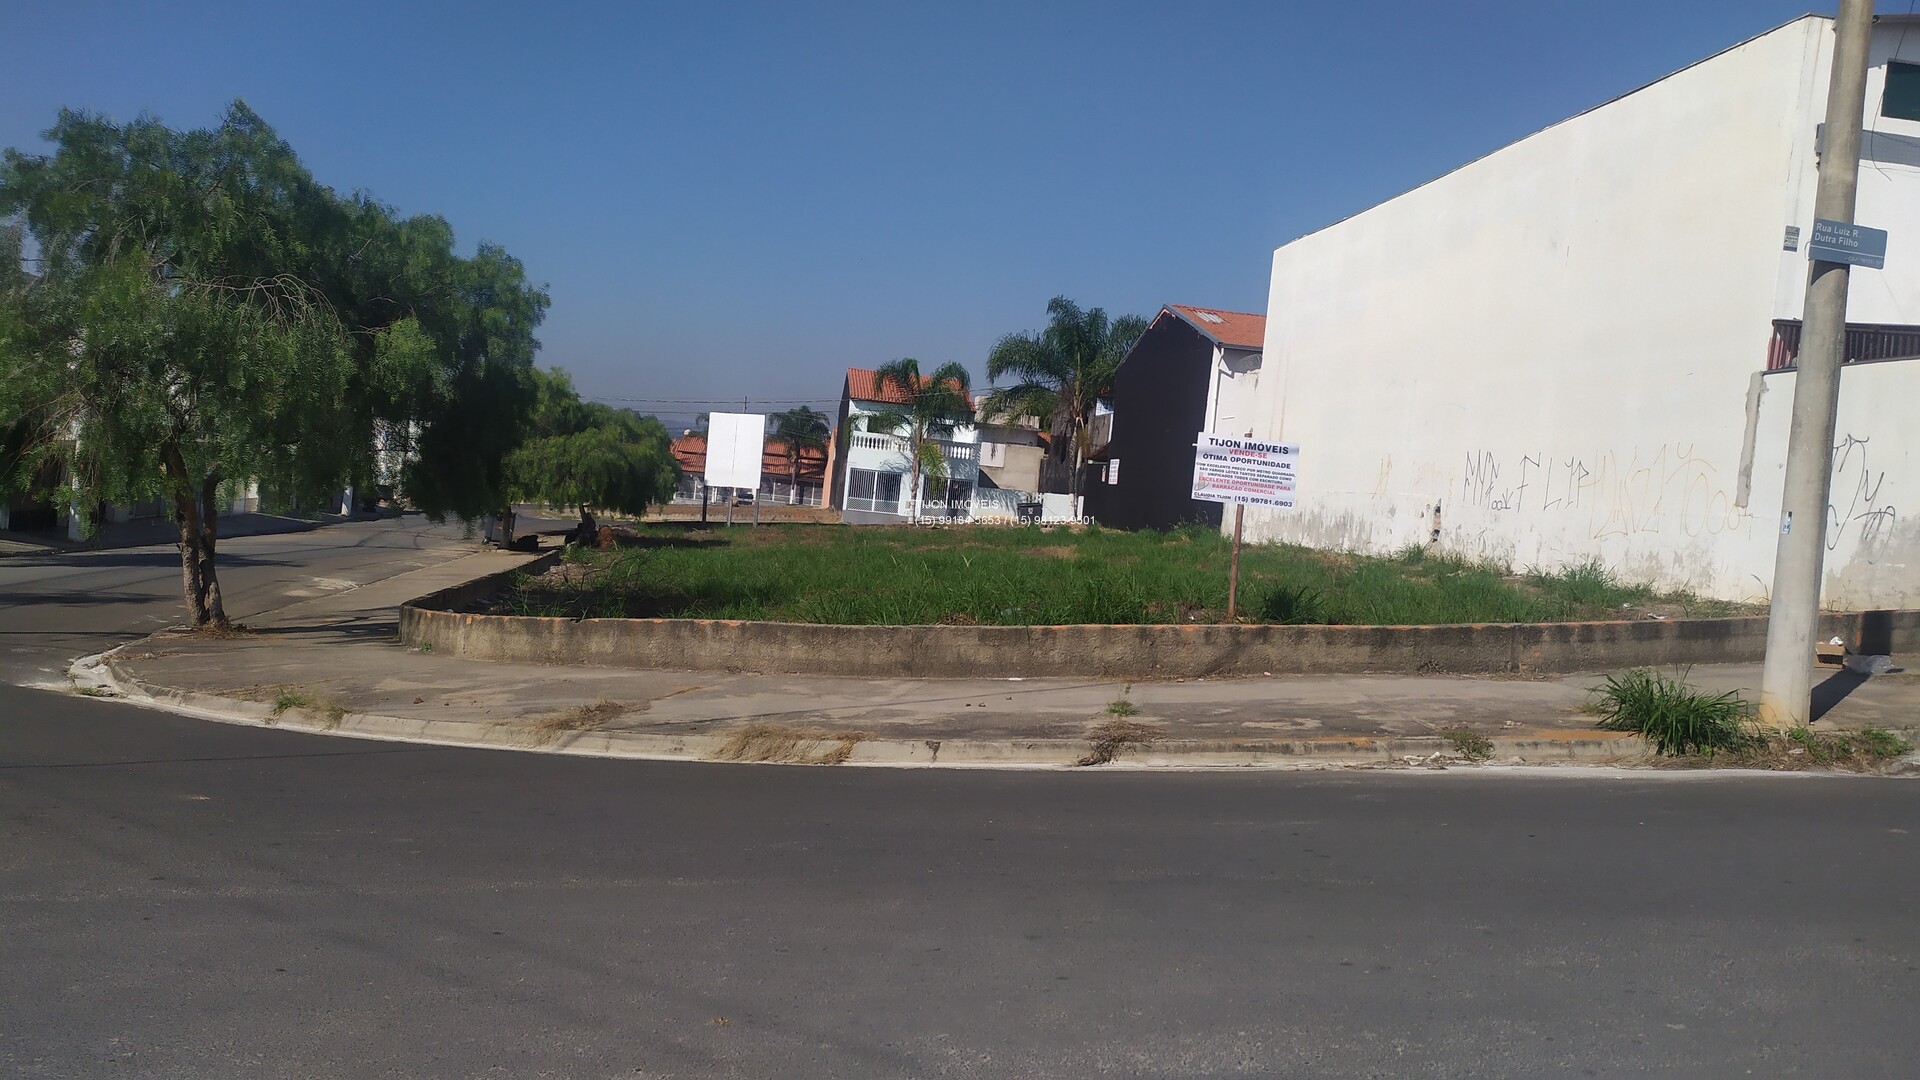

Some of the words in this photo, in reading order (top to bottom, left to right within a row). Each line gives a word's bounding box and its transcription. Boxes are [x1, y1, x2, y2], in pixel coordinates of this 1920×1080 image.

[1816, 223, 1832, 233] Rua
[1834, 226, 1850, 237] Luiz
[1815, 232, 1836, 244] Dutra
[1838, 236, 1859, 248] Filho
[1209, 437, 1241, 449] TIJON
[1244, 441, 1289, 455] IMÓVEIS
[1203, 452, 1228, 462] ÓTIMA
[1230, 456, 1291, 469] OPORTUNIDADE
[1229, 448, 1268, 459] VENDE-SE
[1199, 476, 1231, 484] EXCELENTE
[1231, 479, 1275, 490] OPORTUNIDADE
[1243, 486, 1276, 496] COMERCIAL
[1234, 495, 1249, 503] (15)
[1250, 497, 1293, 508] 99781.6903
